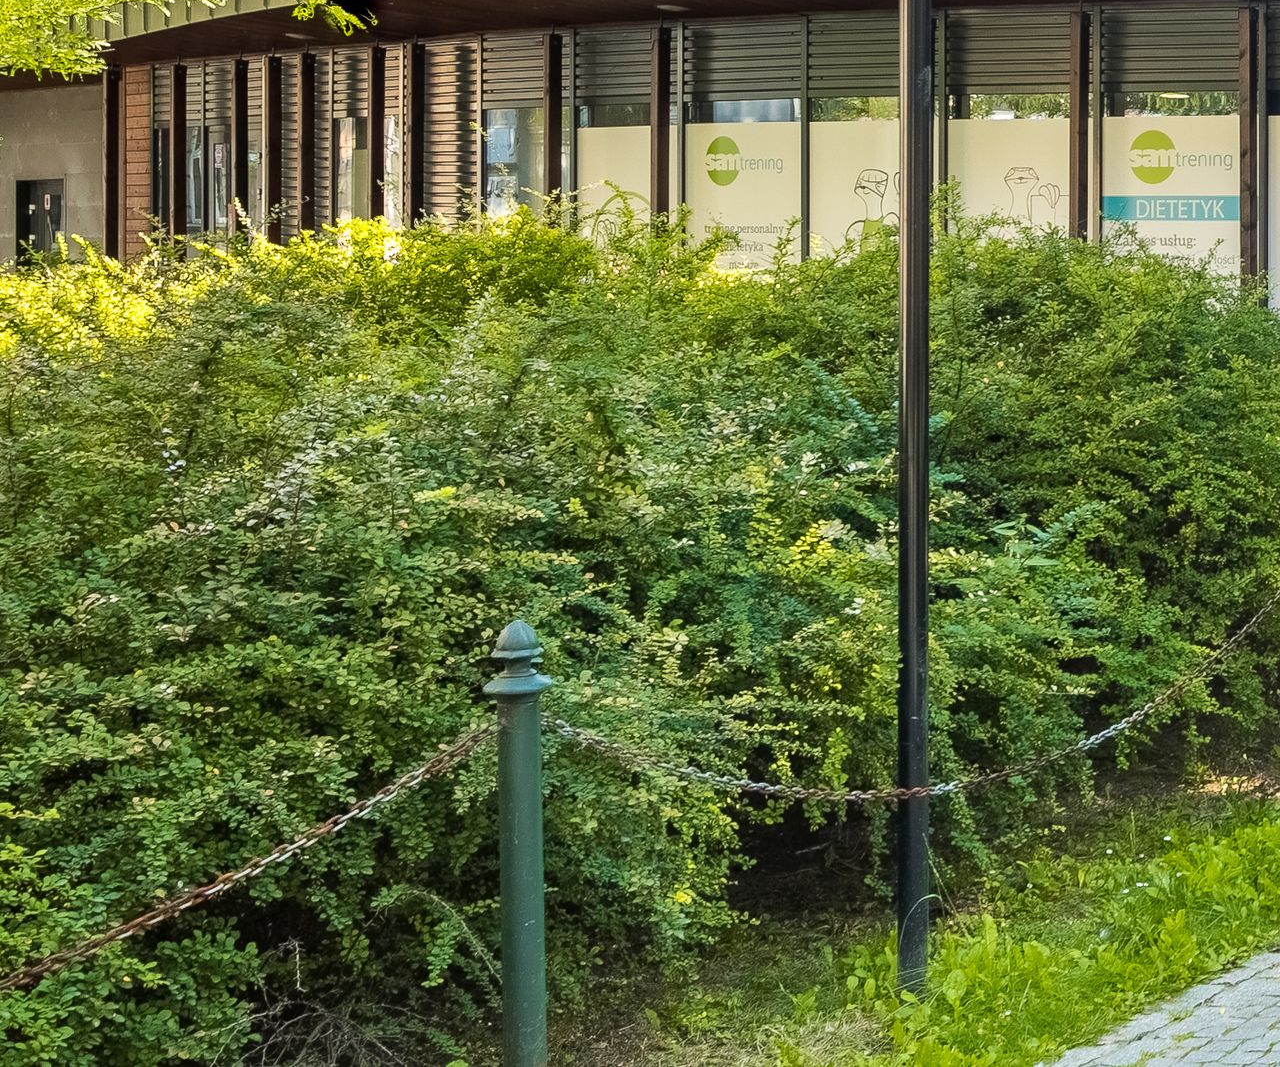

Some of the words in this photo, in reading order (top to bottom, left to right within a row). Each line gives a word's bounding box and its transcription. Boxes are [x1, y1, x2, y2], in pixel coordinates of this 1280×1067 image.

[1135, 199, 1225, 219] DIETETYK
[737, 223, 784, 235] personalny
[1160, 234, 1197, 248] usług:
